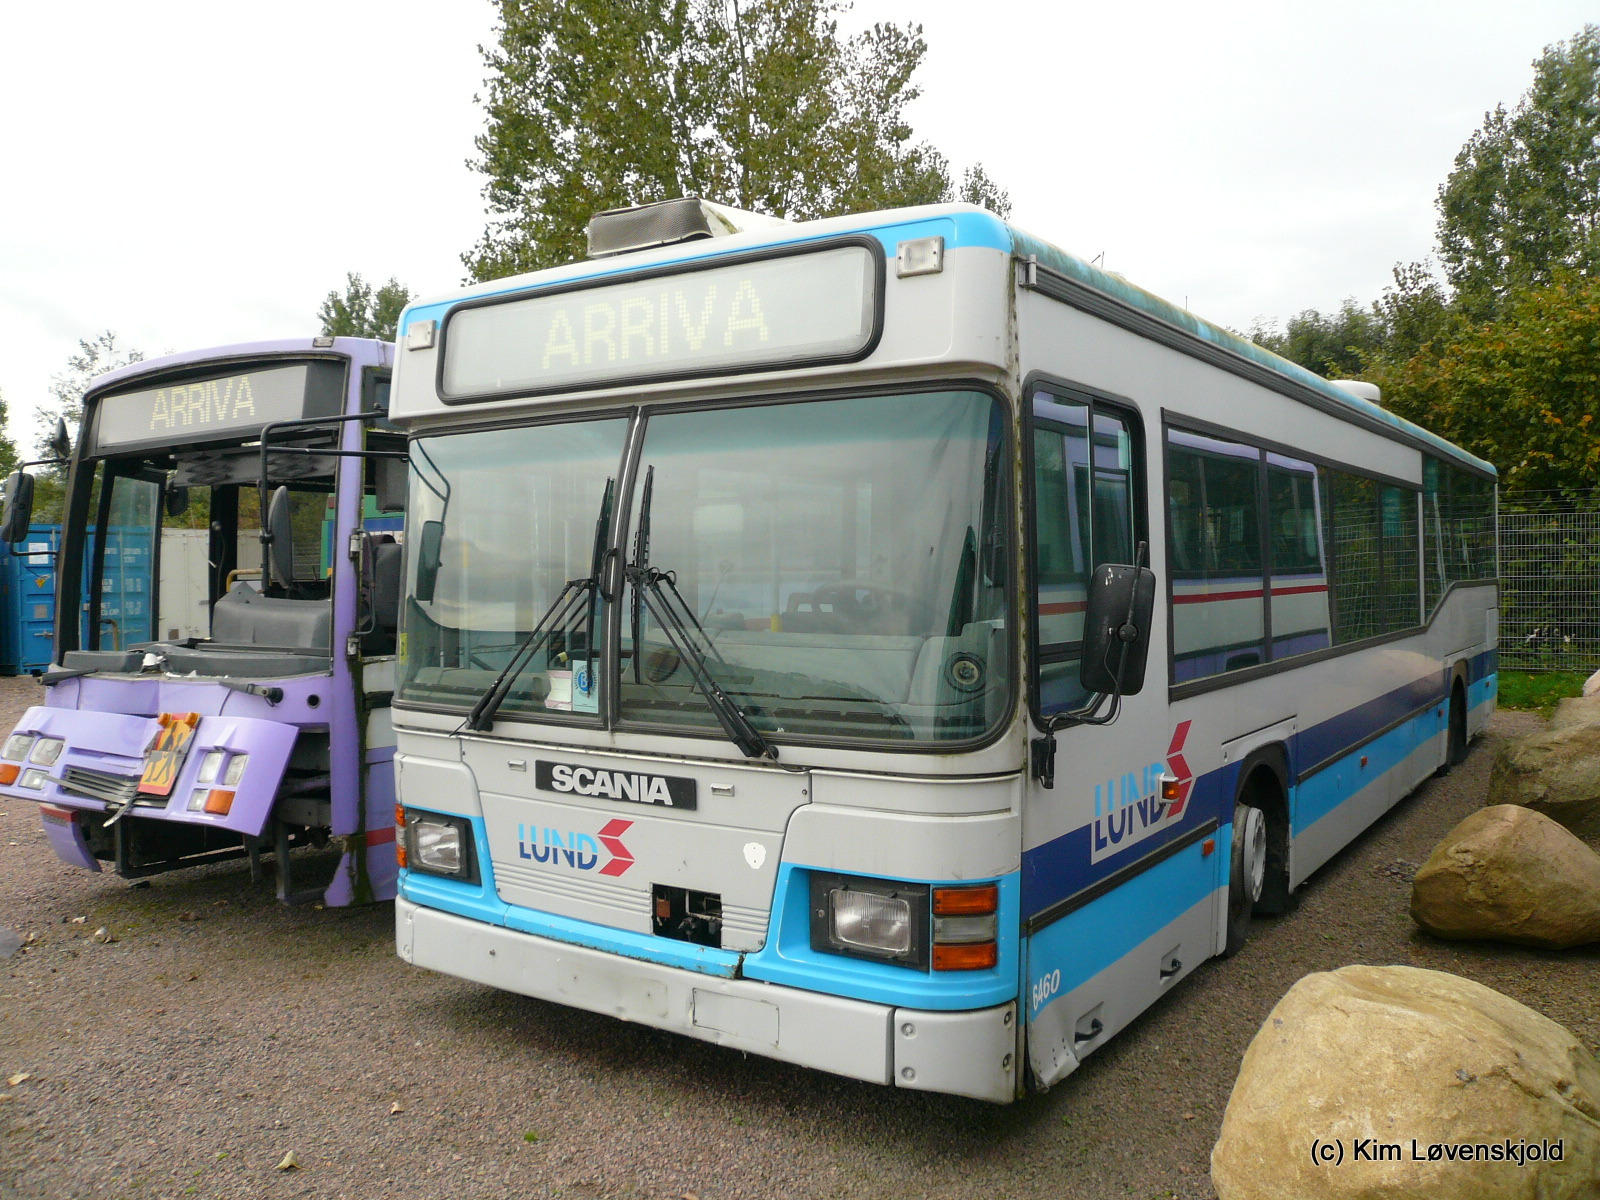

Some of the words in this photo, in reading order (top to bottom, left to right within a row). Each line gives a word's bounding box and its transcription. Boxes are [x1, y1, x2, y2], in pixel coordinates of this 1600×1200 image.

[542, 280, 768, 369] ARRIVA
[150, 377, 255, 430] ARRIVA
[552, 765, 673, 806] SCANIA
[518, 824, 598, 870] LUND
[1033, 969, 1060, 1011] 6460
